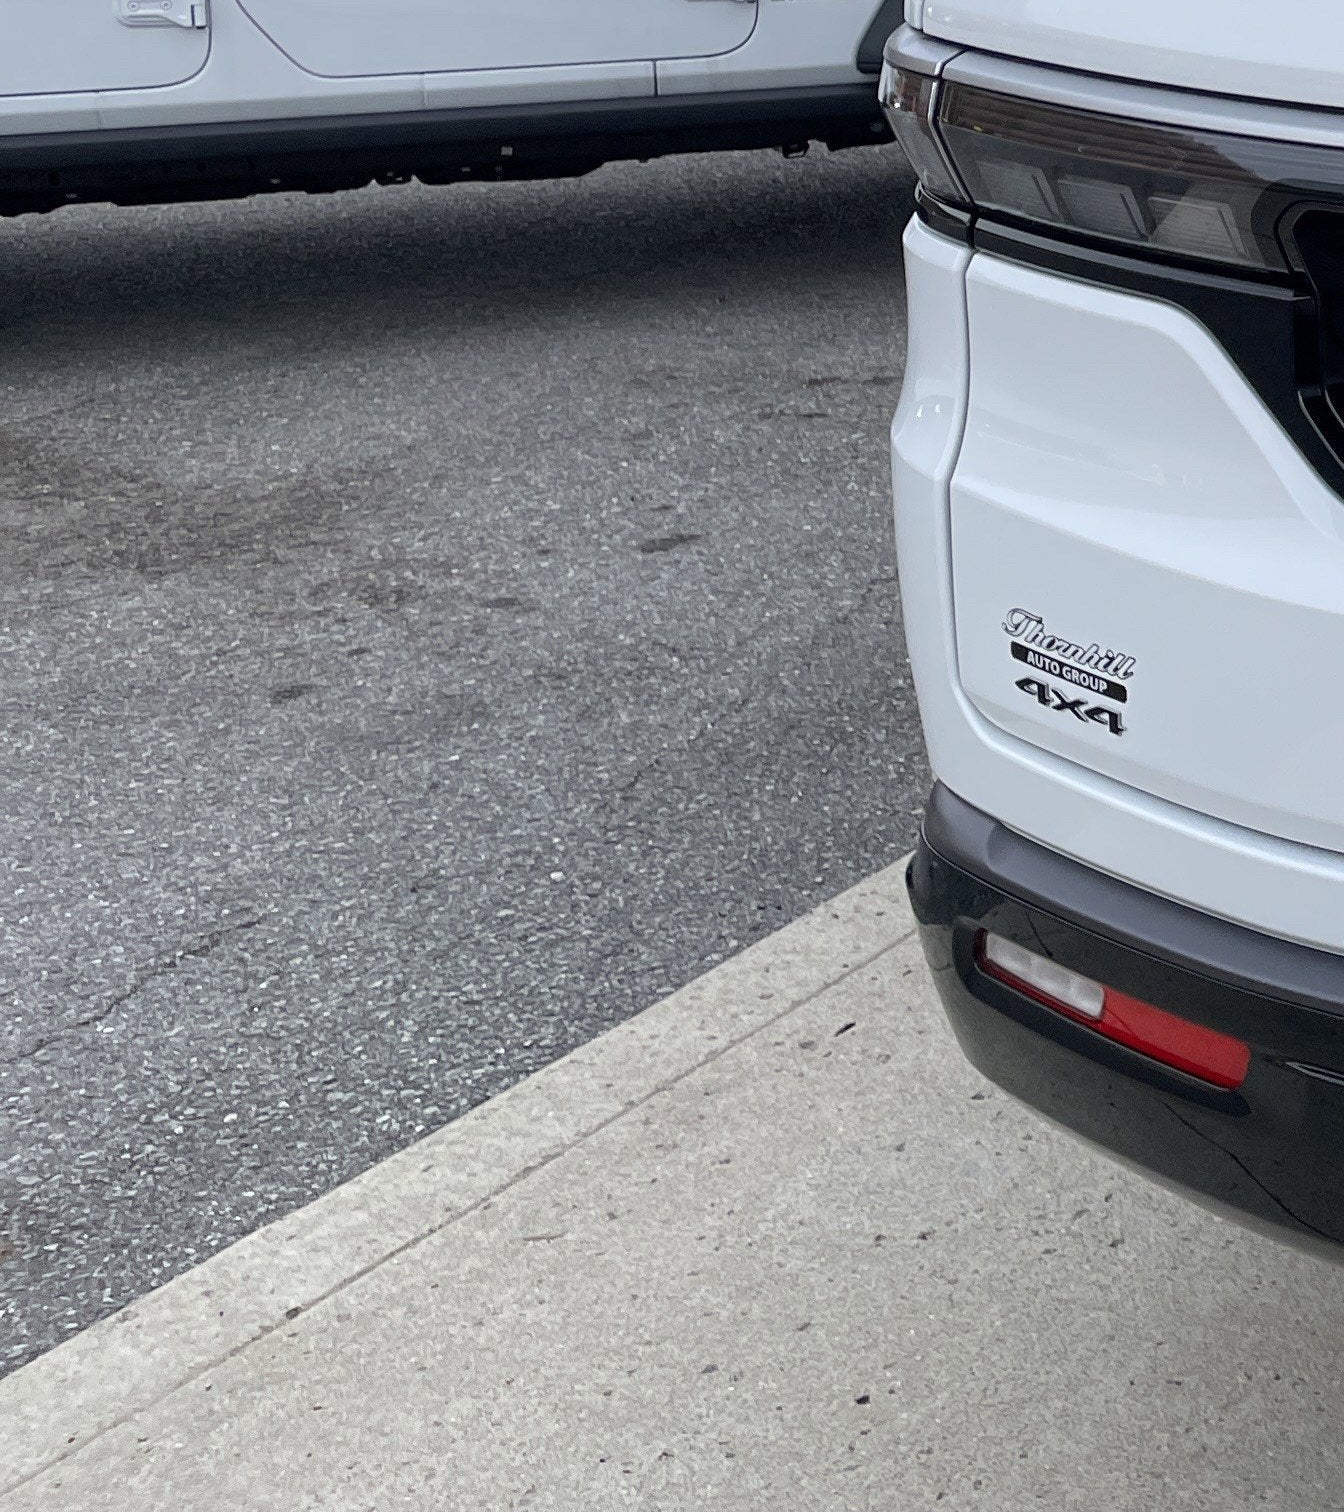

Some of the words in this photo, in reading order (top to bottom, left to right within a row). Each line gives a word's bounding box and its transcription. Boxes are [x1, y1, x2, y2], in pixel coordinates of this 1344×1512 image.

[1001, 607, 1136, 680] Thornhill
[1026, 649, 1060, 676] AUTO
[1062, 666, 1108, 694] GROUP
